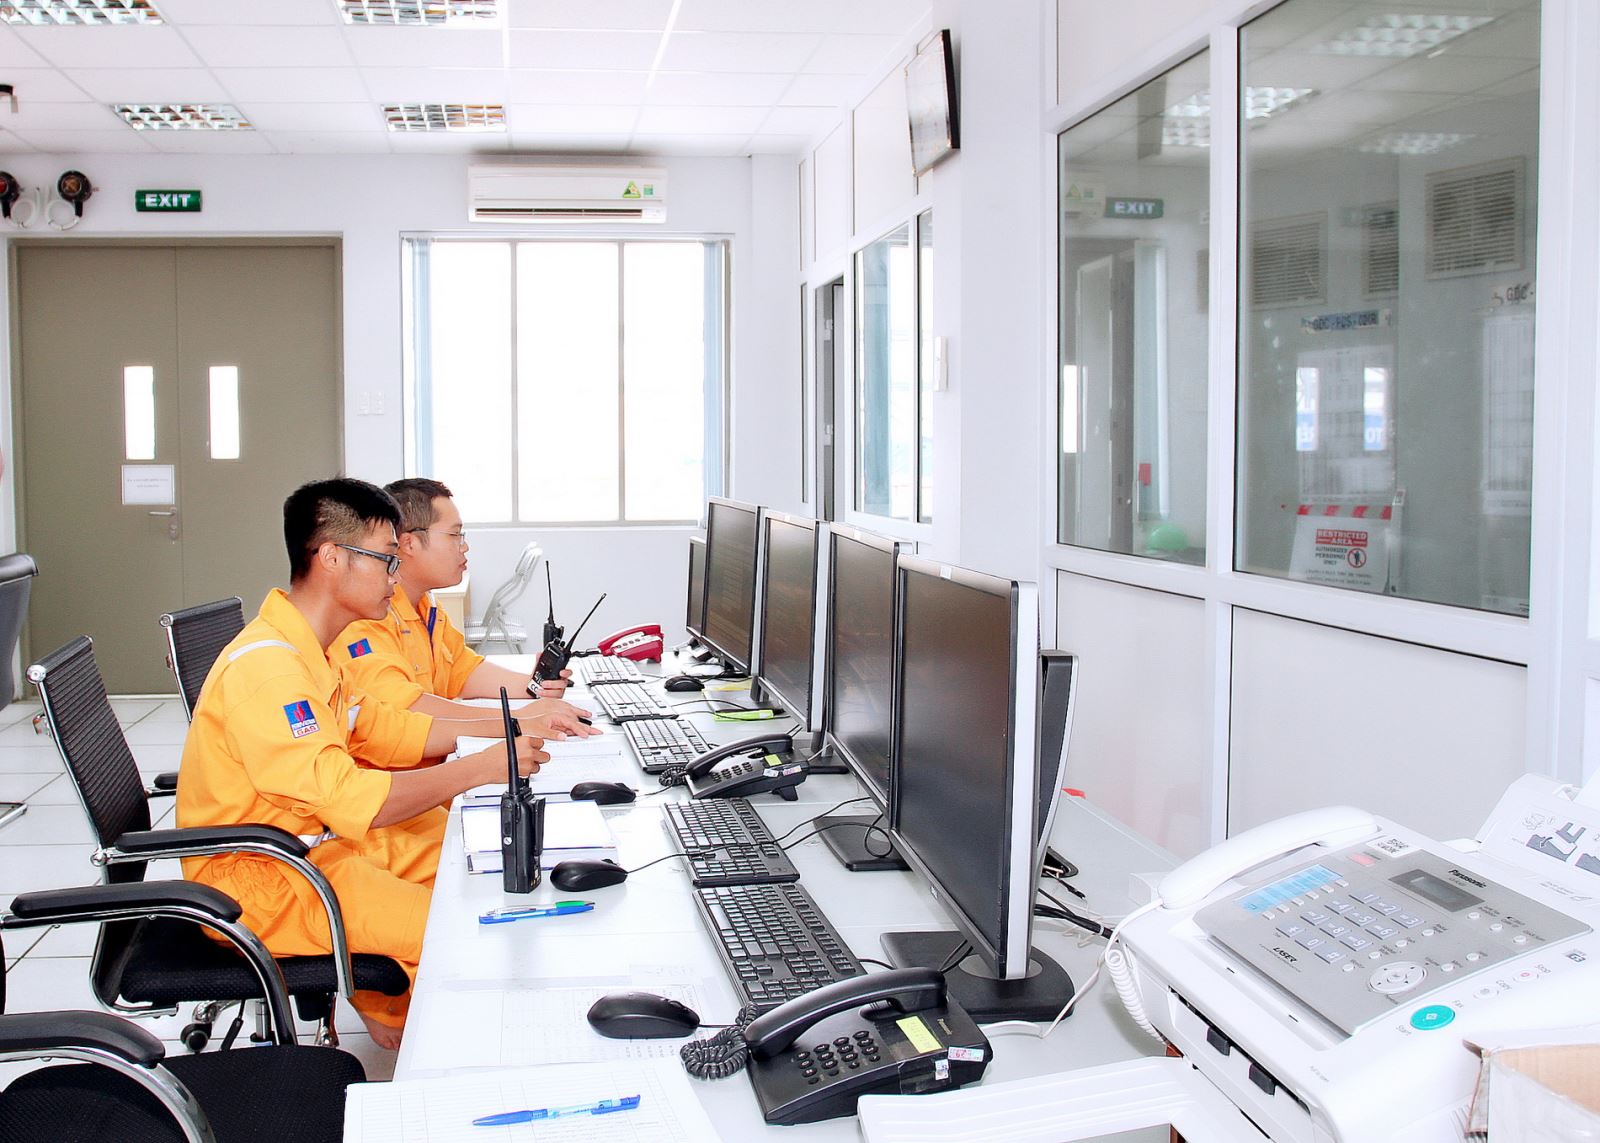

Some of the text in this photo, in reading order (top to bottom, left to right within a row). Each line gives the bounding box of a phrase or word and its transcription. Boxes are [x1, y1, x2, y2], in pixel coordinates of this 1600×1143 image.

[145, 193, 191, 207] EXIT
[1114, 201, 1155, 215] EXIT
[1317, 530, 1367, 540] RESTRICTED
[1331, 538, 1353, 546] AREA
[297, 725, 317, 736] GAS
[1448, 869, 1487, 889] Panasonic
[1273, 946, 1298, 963] LASER
[1535, 964, 1552, 974] Stop
[1496, 980, 1512, 990] Copy
